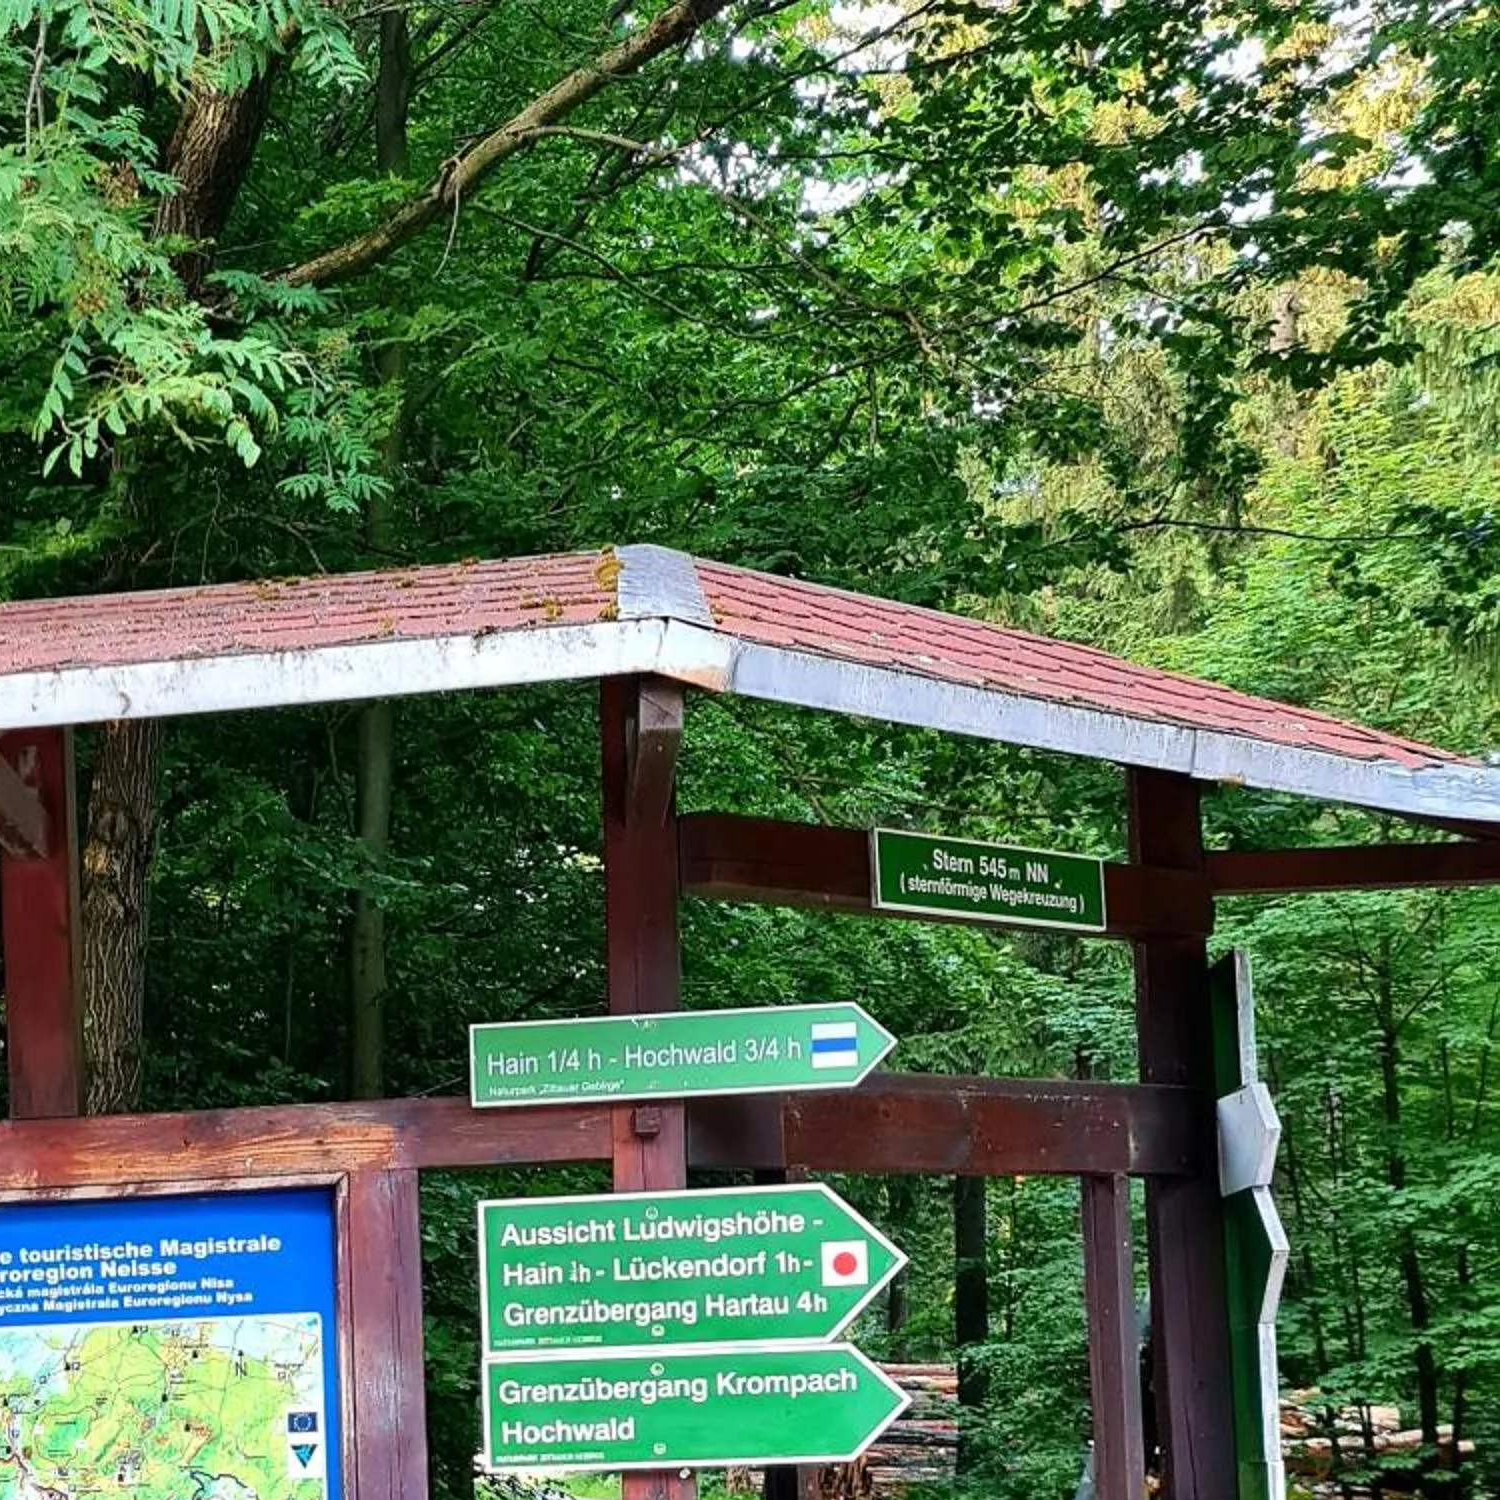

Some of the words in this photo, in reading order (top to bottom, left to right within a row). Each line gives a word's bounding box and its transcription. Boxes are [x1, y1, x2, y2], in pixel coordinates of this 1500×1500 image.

[933, 849, 974, 874] Stern
[1026, 862, 1049, 883] NN
[488, 1051, 538, 1076] Hain
[547, 1047, 579, 1072] 1/4
[587, 1047, 601, 1071] h
[624, 1040, 737, 1070] Hochwald
[744, 1039, 778, 1063] 3/4
[788, 1039, 802, 1060] h
[501, 1220, 615, 1247] Aussicht
[622, 1211, 805, 1242] Ludwigshöhe
[19, 1241, 153, 1264] touristische
[159, 1234, 282, 1259] Magistrale
[100, 1260, 177, 1279] Neisse
[107, 1280, 197, 1295] Euroregionu
[200, 1276, 235, 1289] Nisa
[503, 1263, 563, 1286] Hain
[613, 1251, 766, 1281] Lückendorf
[43, 1296, 120, 1313] Magistrala
[123, 1293, 213, 1308] Euroregionu
[216, 1290, 253, 1306] Nysa
[504, 1298, 697, 1327] Grenzübergang
[705, 1292, 789, 1317] Hartau
[797, 1290, 827, 1314] 4h
[499, 1375, 708, 1406] Grenzübergang
[716, 1368, 858, 1398] Krompach
[502, 1417, 635, 1445] Hochwald
